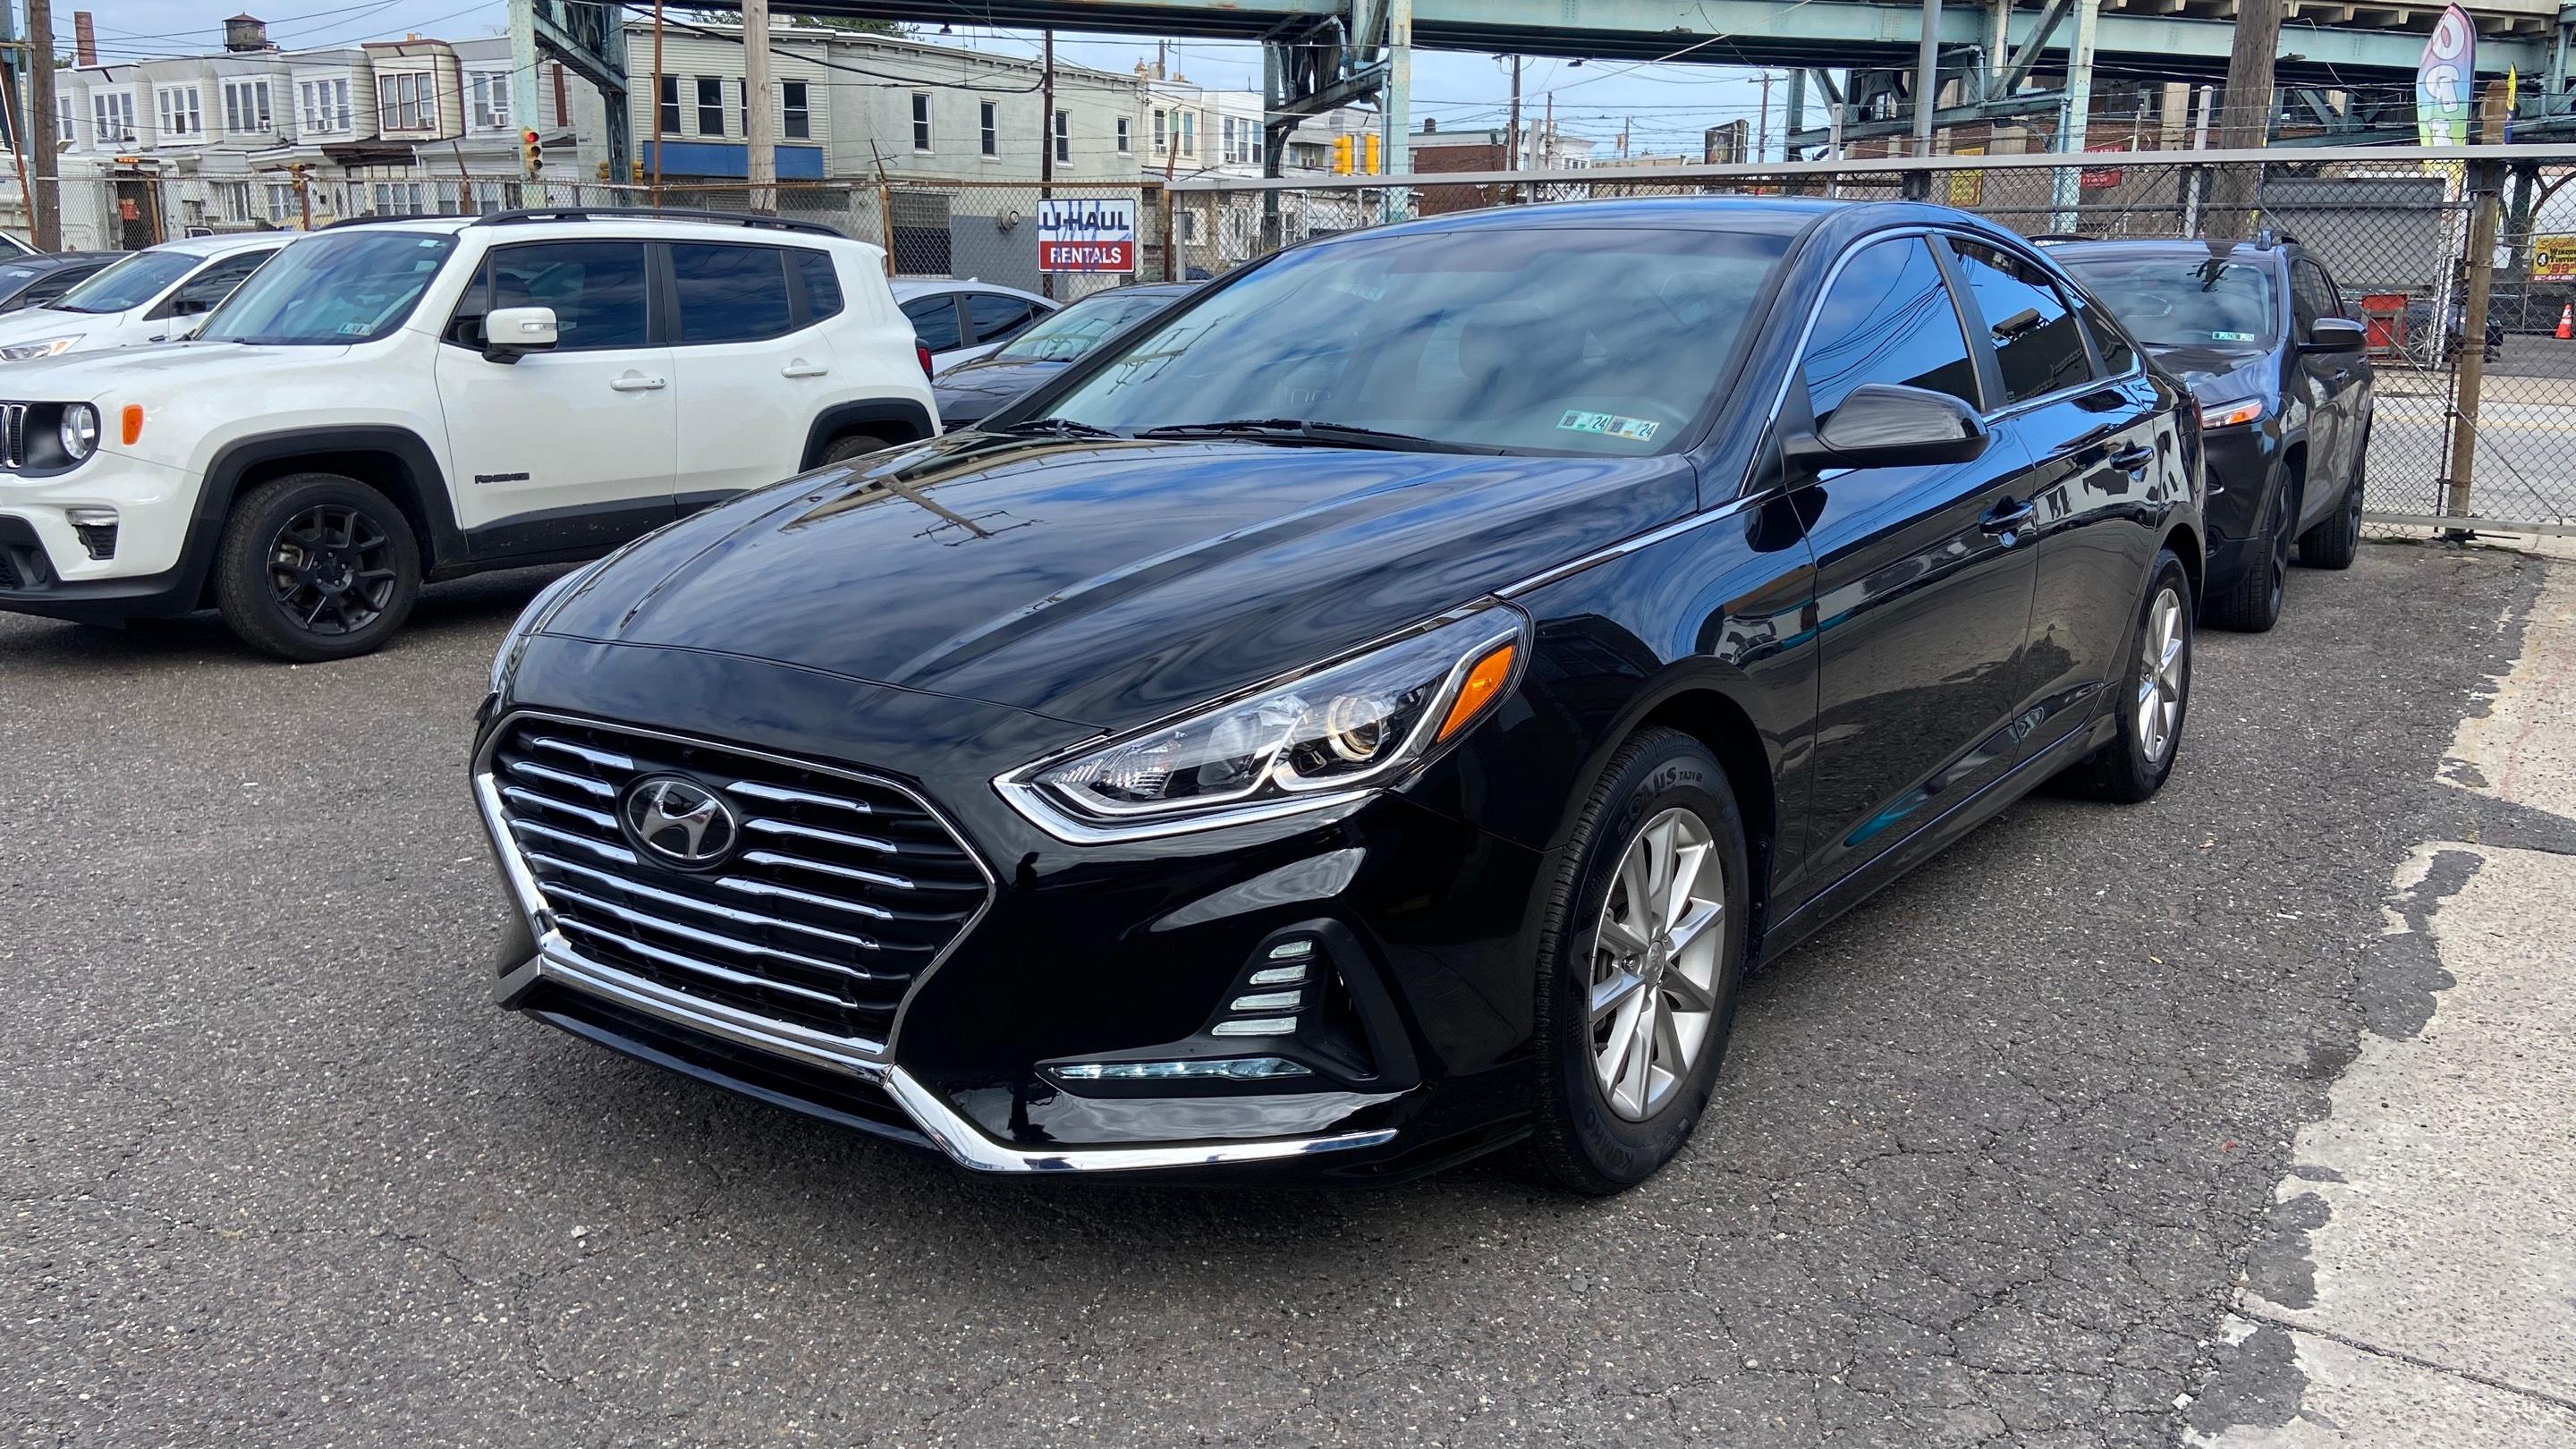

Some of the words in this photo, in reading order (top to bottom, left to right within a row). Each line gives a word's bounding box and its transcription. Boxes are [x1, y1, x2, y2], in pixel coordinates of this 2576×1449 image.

[1043, 211, 1130, 231] U-HAUL
[1050, 247, 1122, 264] RENTALS
[1592, 416, 1609, 430] 24
[1639, 423, 1656, 437] 24
